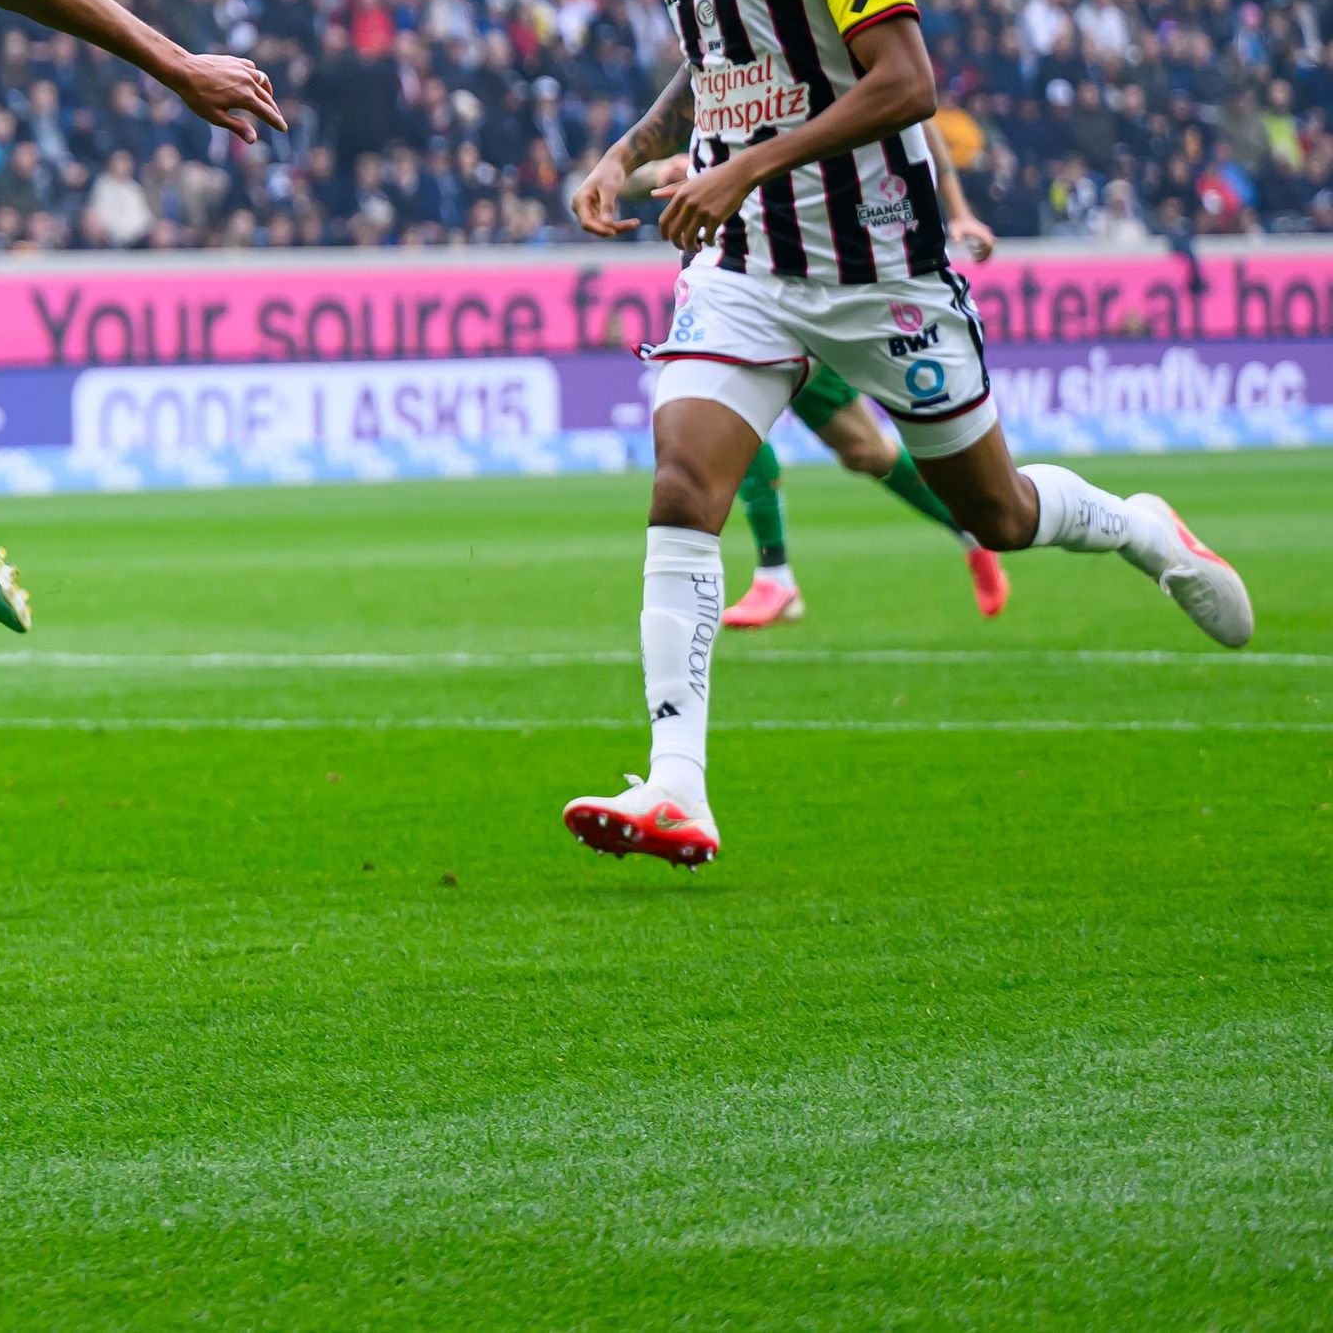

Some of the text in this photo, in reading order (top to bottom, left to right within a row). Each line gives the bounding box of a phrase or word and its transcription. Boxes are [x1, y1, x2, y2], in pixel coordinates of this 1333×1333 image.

[858, 199, 911, 220] CHANGE
[870, 211, 912, 227] WORLD
[33, 287, 229, 365] Your
[257, 291, 546, 361] source
[979, 268, 1123, 341] ater
[1233, 256, 1333, 338] ho
[887, 323, 939, 357] BWT
[688, 573, 719, 701] MOLTO LUCE
